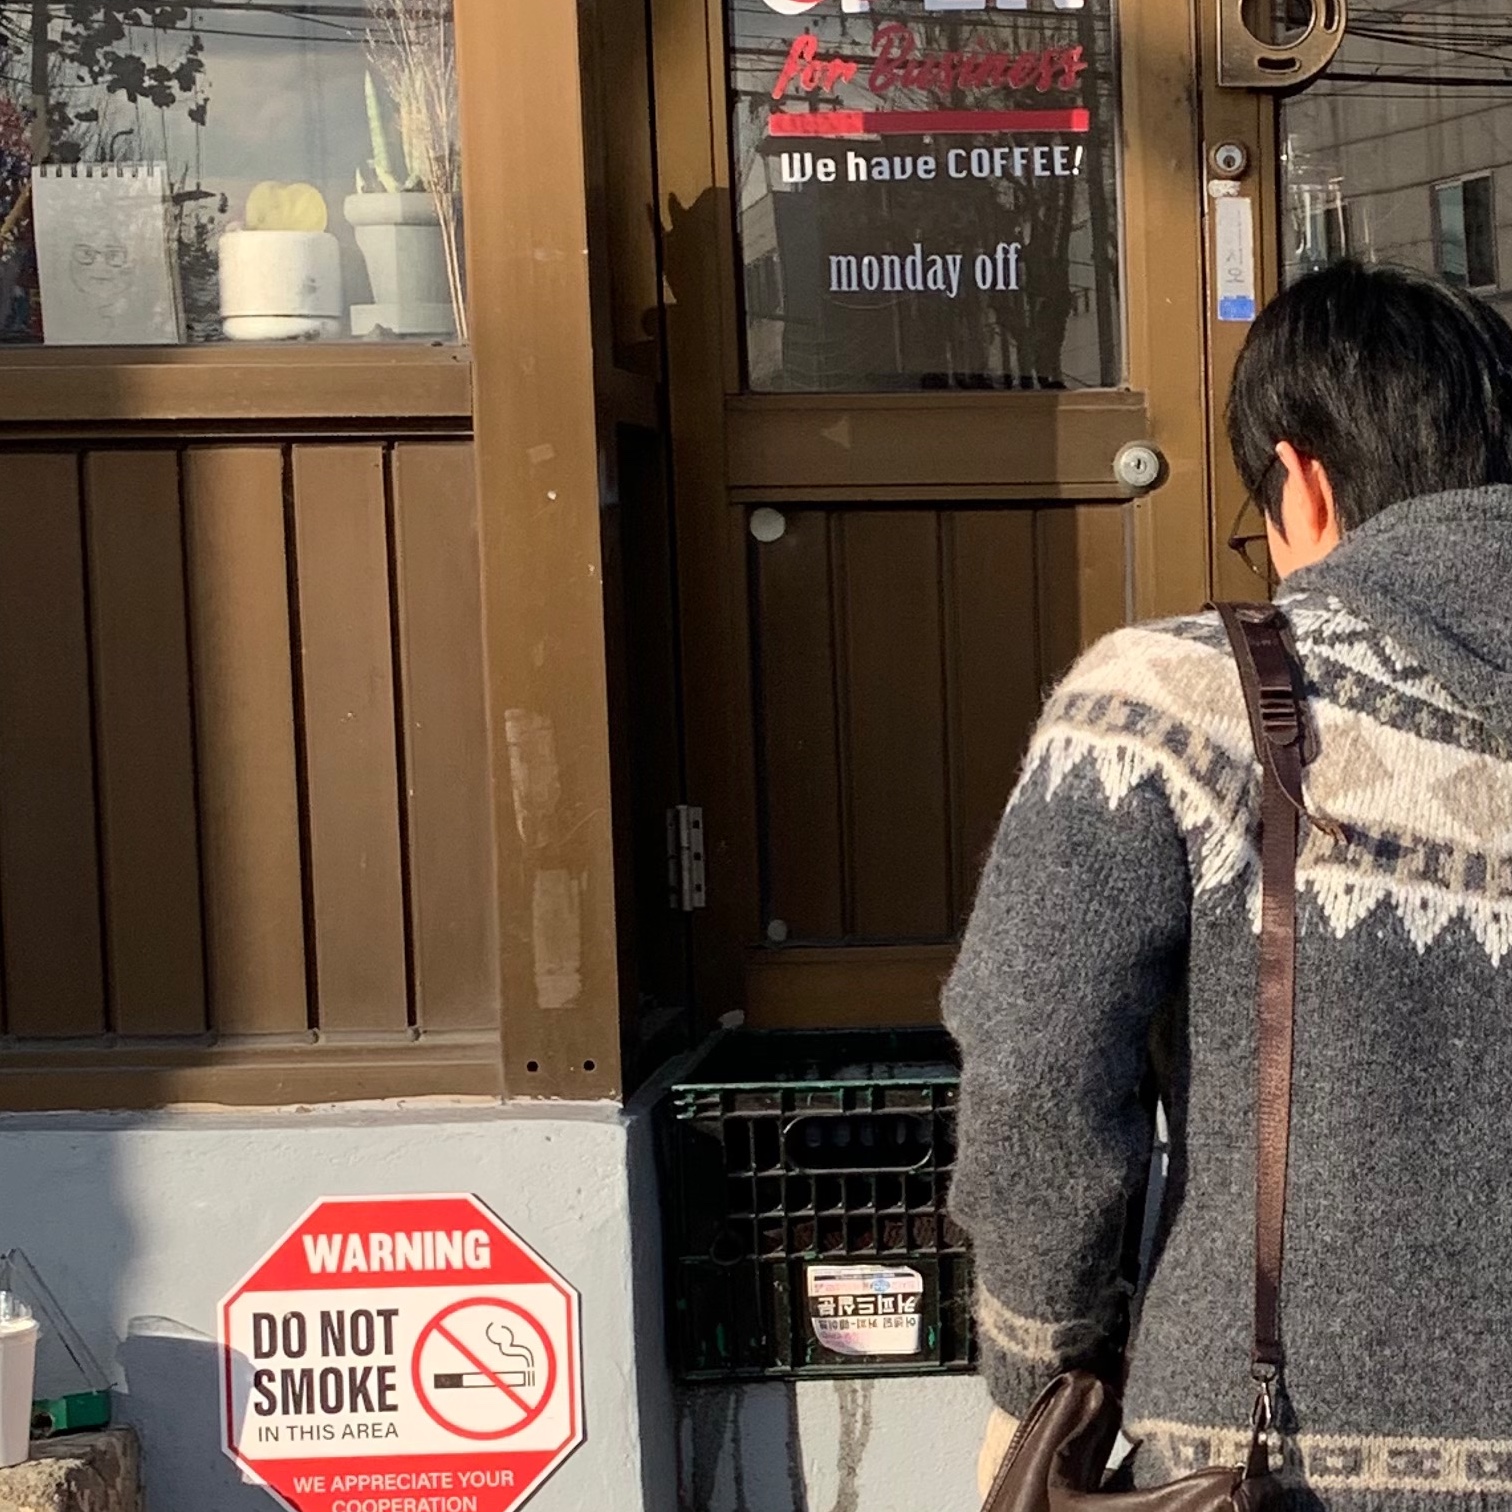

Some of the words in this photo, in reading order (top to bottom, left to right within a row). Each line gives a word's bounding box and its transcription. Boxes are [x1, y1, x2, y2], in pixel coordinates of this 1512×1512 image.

[771, 32, 858, 99] for
[867, 23, 1088, 93] Business
[782, 149, 836, 183] We
[848, 147, 936, 181] have
[947, 145, 1084, 180] COFFEE!
[829, 243, 962, 298] monday
[974, 243, 1022, 291] off
[302, 1229, 491, 1273] WARNING
[252, 1311, 307, 1359] DO
[320, 1308, 399, 1357] NOT
[254, 1365, 399, 1416] SMOKE
[258, 1426, 279, 1442] IN
[286, 1424, 335, 1441] THIS
[341, 1422, 399, 1440] AREA
[293, 1476, 326, 1494] WE
[330, 1472, 453, 1492] APPRECIATE
[458, 1470, 514, 1488] YOUR
